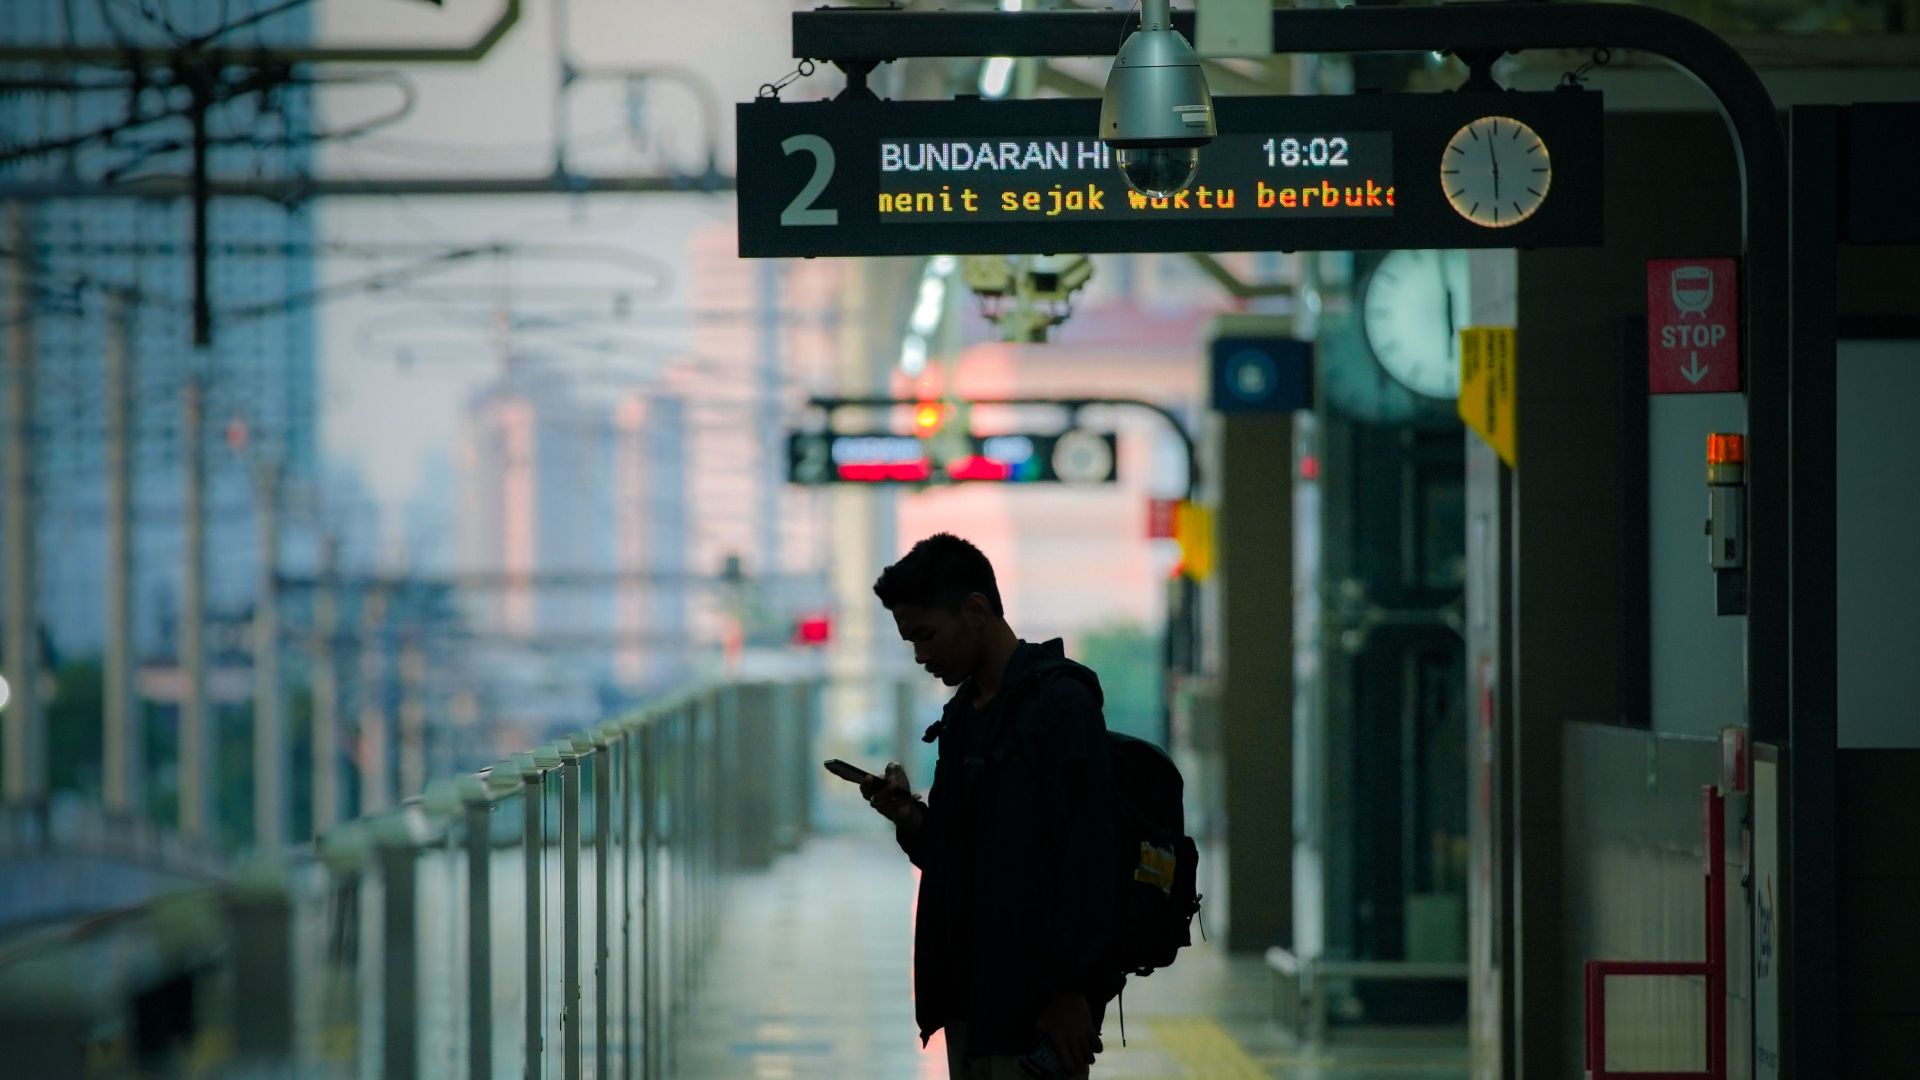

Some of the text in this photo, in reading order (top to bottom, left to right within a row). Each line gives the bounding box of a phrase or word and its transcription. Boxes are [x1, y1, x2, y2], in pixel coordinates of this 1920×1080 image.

[881, 141, 1069, 171] BUNDARAN
[1262, 137, 1349, 167] 18:02
[780, 134, 838, 226] 2
[1001, 184, 1105, 216] sejak
[1661, 324, 1726, 349] STOP
